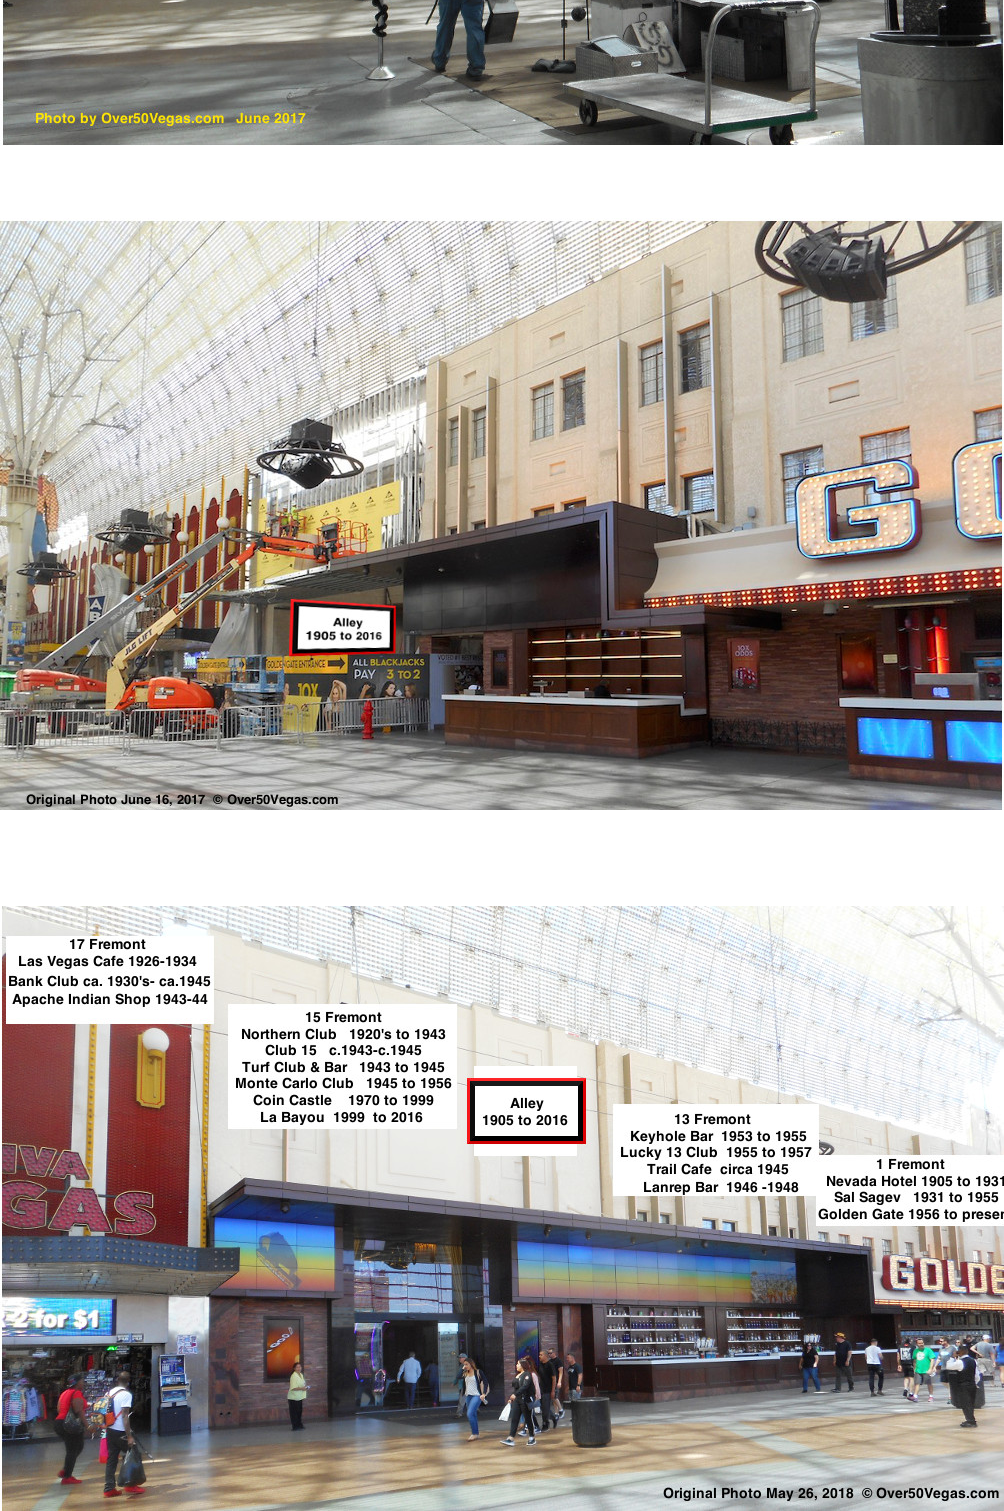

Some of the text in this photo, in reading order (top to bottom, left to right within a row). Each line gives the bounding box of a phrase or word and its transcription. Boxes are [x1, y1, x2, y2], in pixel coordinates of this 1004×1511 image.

[124, 628, 153, 657] JLG LIFT
[352, 658, 425, 667] ALL BLACKJACKS
[354, 669, 421, 680] PAY 3 TO 2
[33, 1308, 69, 1329] for
[73, 1308, 99, 1331] $1
